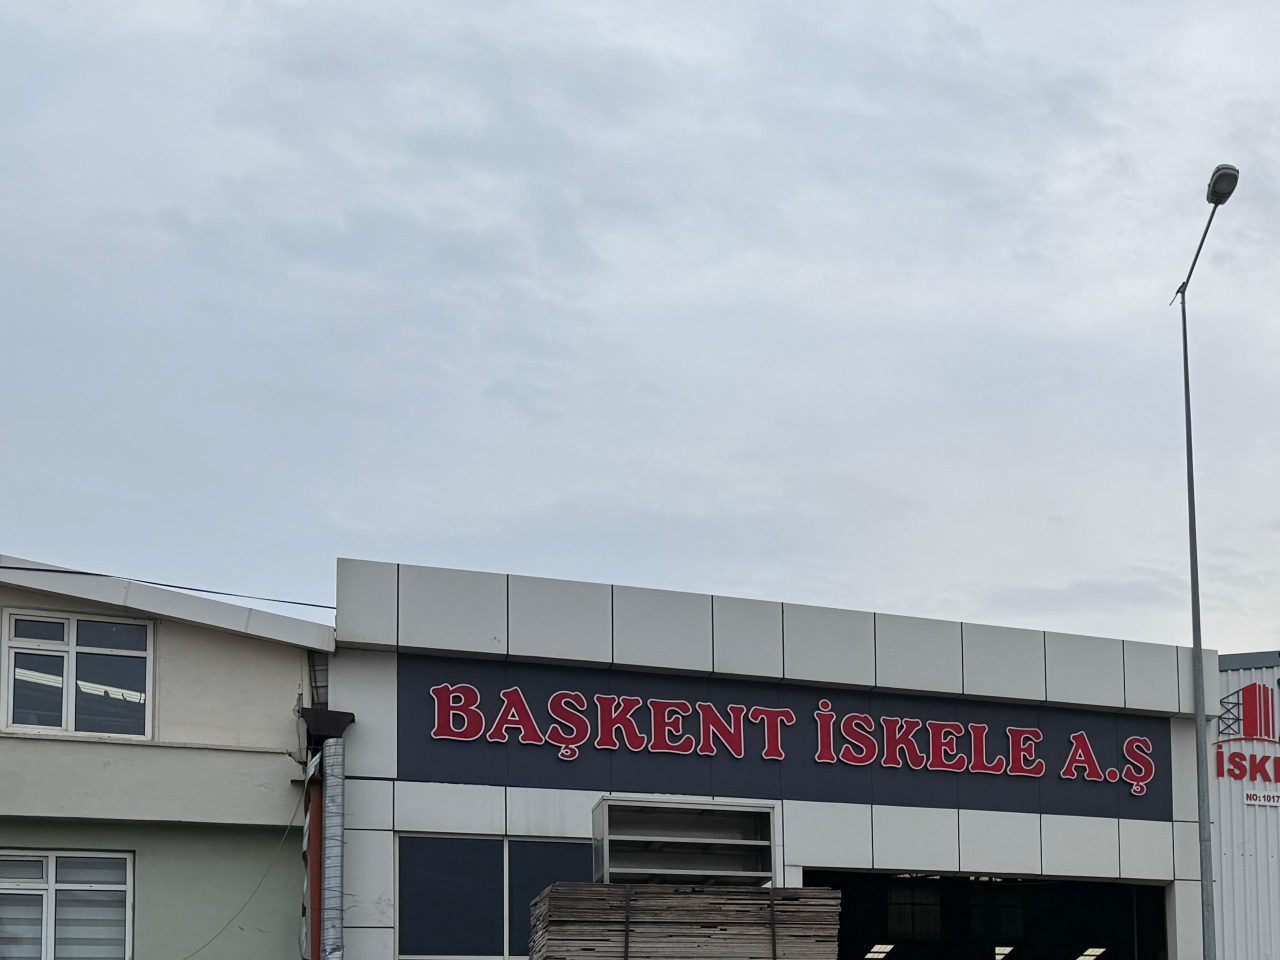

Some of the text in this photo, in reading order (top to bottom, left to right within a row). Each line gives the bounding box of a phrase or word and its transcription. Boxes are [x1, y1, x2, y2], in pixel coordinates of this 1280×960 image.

[430, 682, 1156, 796] BAŞKENT İSKELE A.Ş
